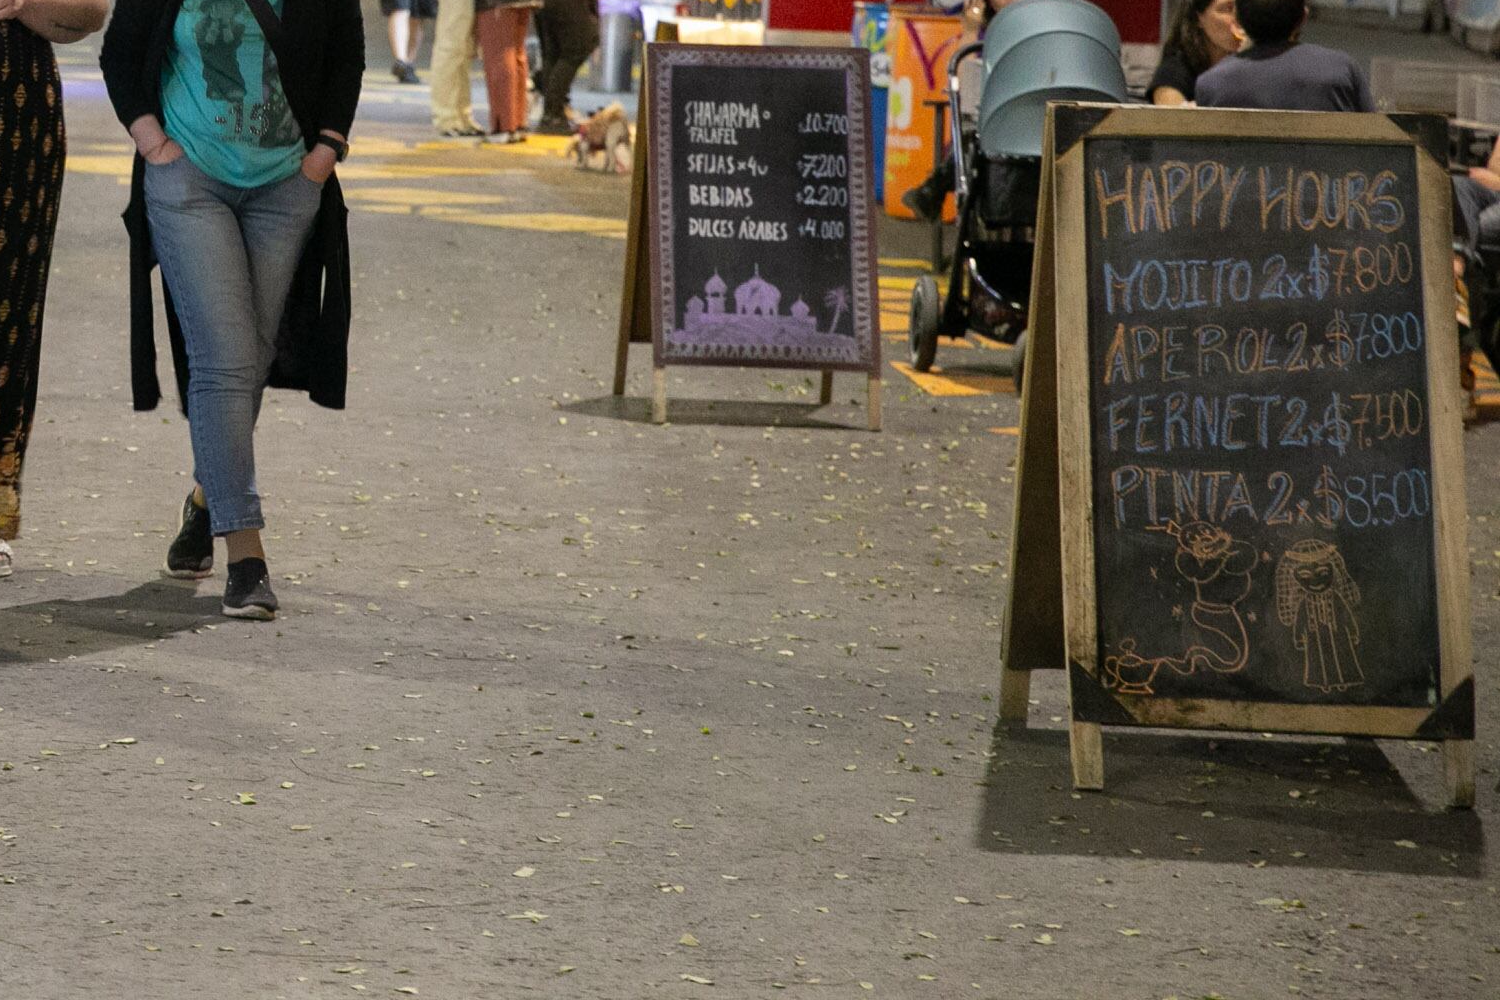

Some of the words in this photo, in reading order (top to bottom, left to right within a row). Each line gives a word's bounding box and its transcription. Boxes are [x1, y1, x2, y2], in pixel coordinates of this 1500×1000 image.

[684, 101, 760, 129] SHAWARMA
[689, 127, 738, 145] FALAFEL
[687, 154, 735, 175] SFIJAS
[688, 185, 753, 208] BEBIDAS
[1094, 161, 1247, 238] HAPPY
[1259, 167, 1403, 233] HOURS
[688, 217, 734, 238] DULCES
[1103, 258, 1251, 314] MOJITO
[1103, 323, 1276, 385] APEROL
[1104, 391, 1281, 452] FERNET
[1110, 465, 1258, 529] PINTA
